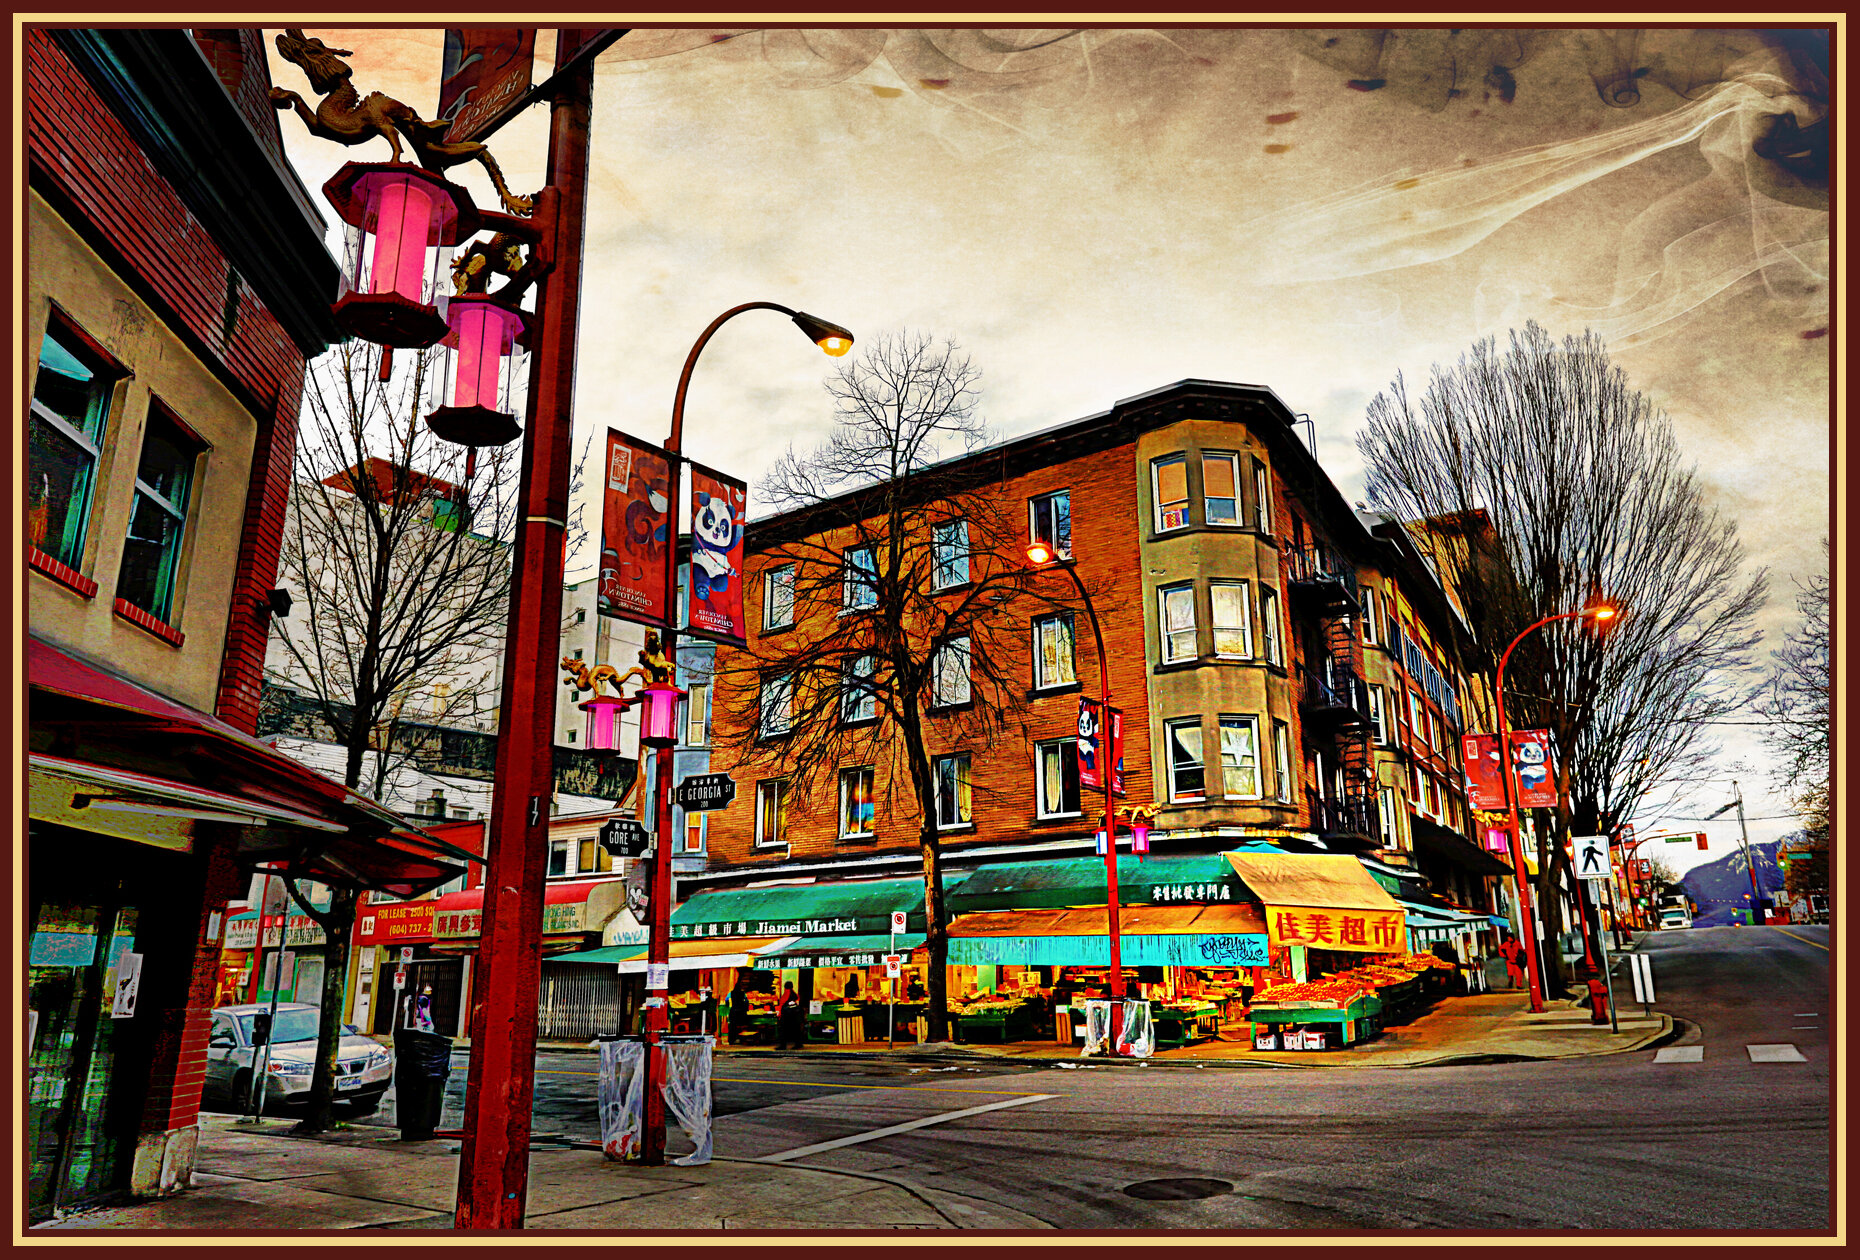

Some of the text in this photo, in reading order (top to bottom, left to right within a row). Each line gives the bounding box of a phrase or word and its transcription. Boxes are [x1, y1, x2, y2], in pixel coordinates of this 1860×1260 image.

[679, 784, 731, 801] E GEORGIA ST
[700, 800, 708, 808] 200
[609, 830, 640, 845] GORE AVE
[620, 846, 629, 854] 700
[377, 908, 389, 920] FOR
[389, 907, 407, 919] LEASE
[389, 924, 407, 937] (604)
[408, 923, 422, 934] 737
[755, 918, 857, 935] Jiamei Market
[1275, 912, 1399, 948] 佳美超市
